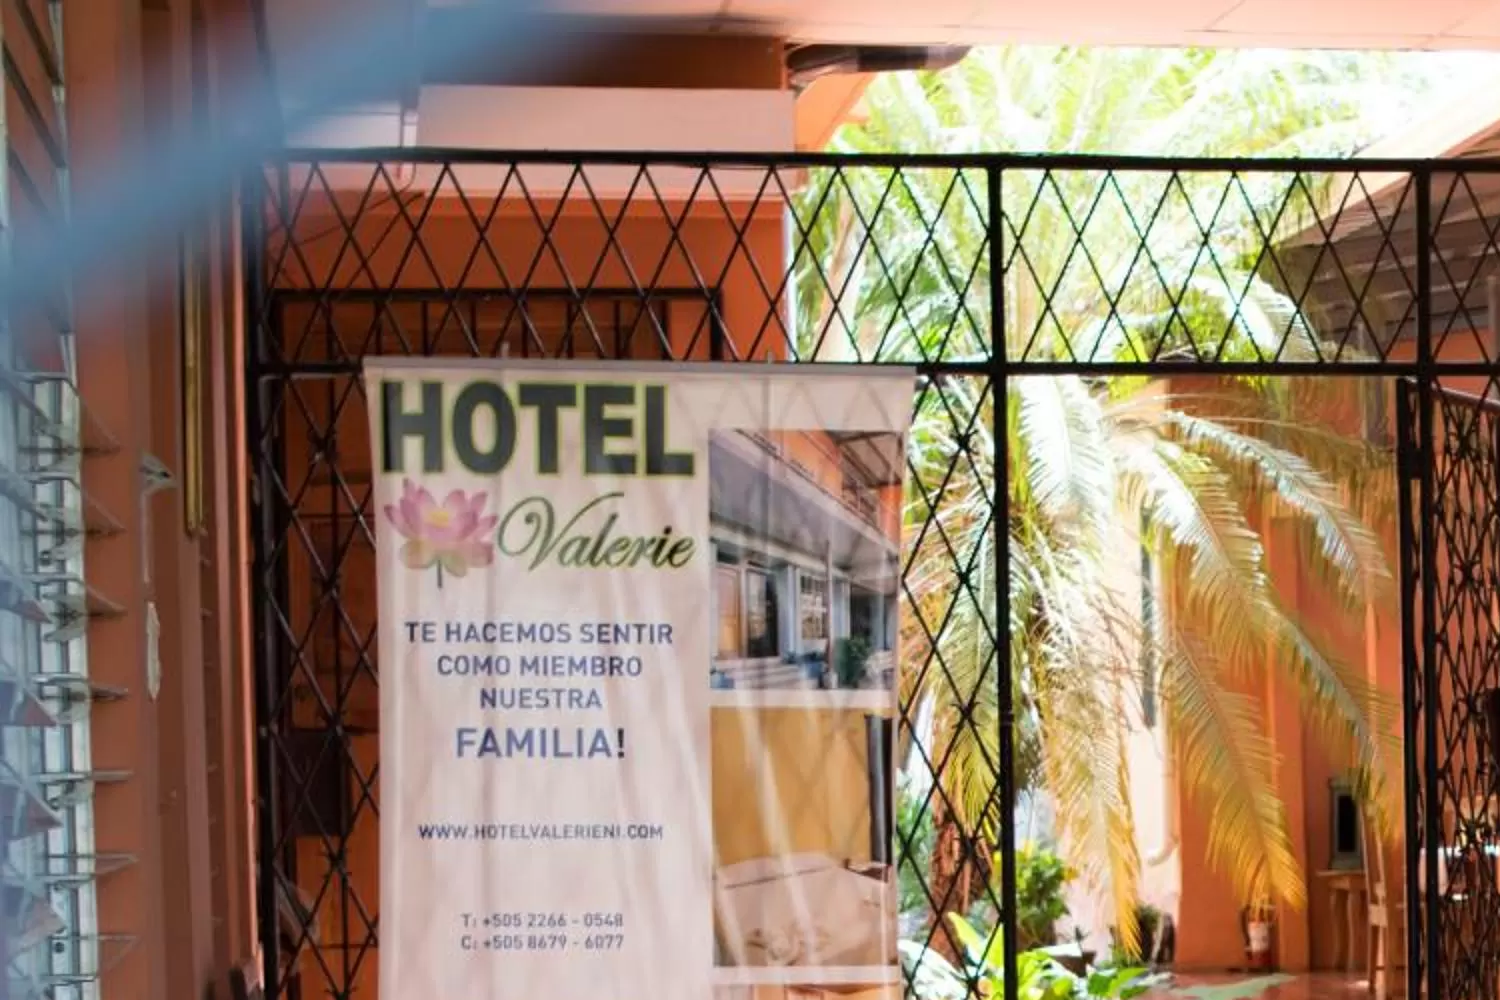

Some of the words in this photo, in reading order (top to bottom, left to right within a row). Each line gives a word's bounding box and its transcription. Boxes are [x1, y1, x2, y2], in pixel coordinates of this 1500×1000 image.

[380, 379, 695, 476] HOTEL
[498, 491, 695, 571] Valerie
[405, 621, 436, 643] TE
[445, 623, 572, 644] HACEMOS
[579, 623, 674, 645] SENTIR
[437, 654, 511, 677] COMO
[519, 655, 643, 678] MIEMBRO
[479, 688, 603, 710] NUESTRA
[456, 727, 626, 759] FAMILIA!
[418, 824, 664, 841] WWW.HOTELVALERIENI.COM
[483, 913, 522, 928] +505
[527, 913, 567, 928] 2266
[583, 913, 624, 928] 0548
